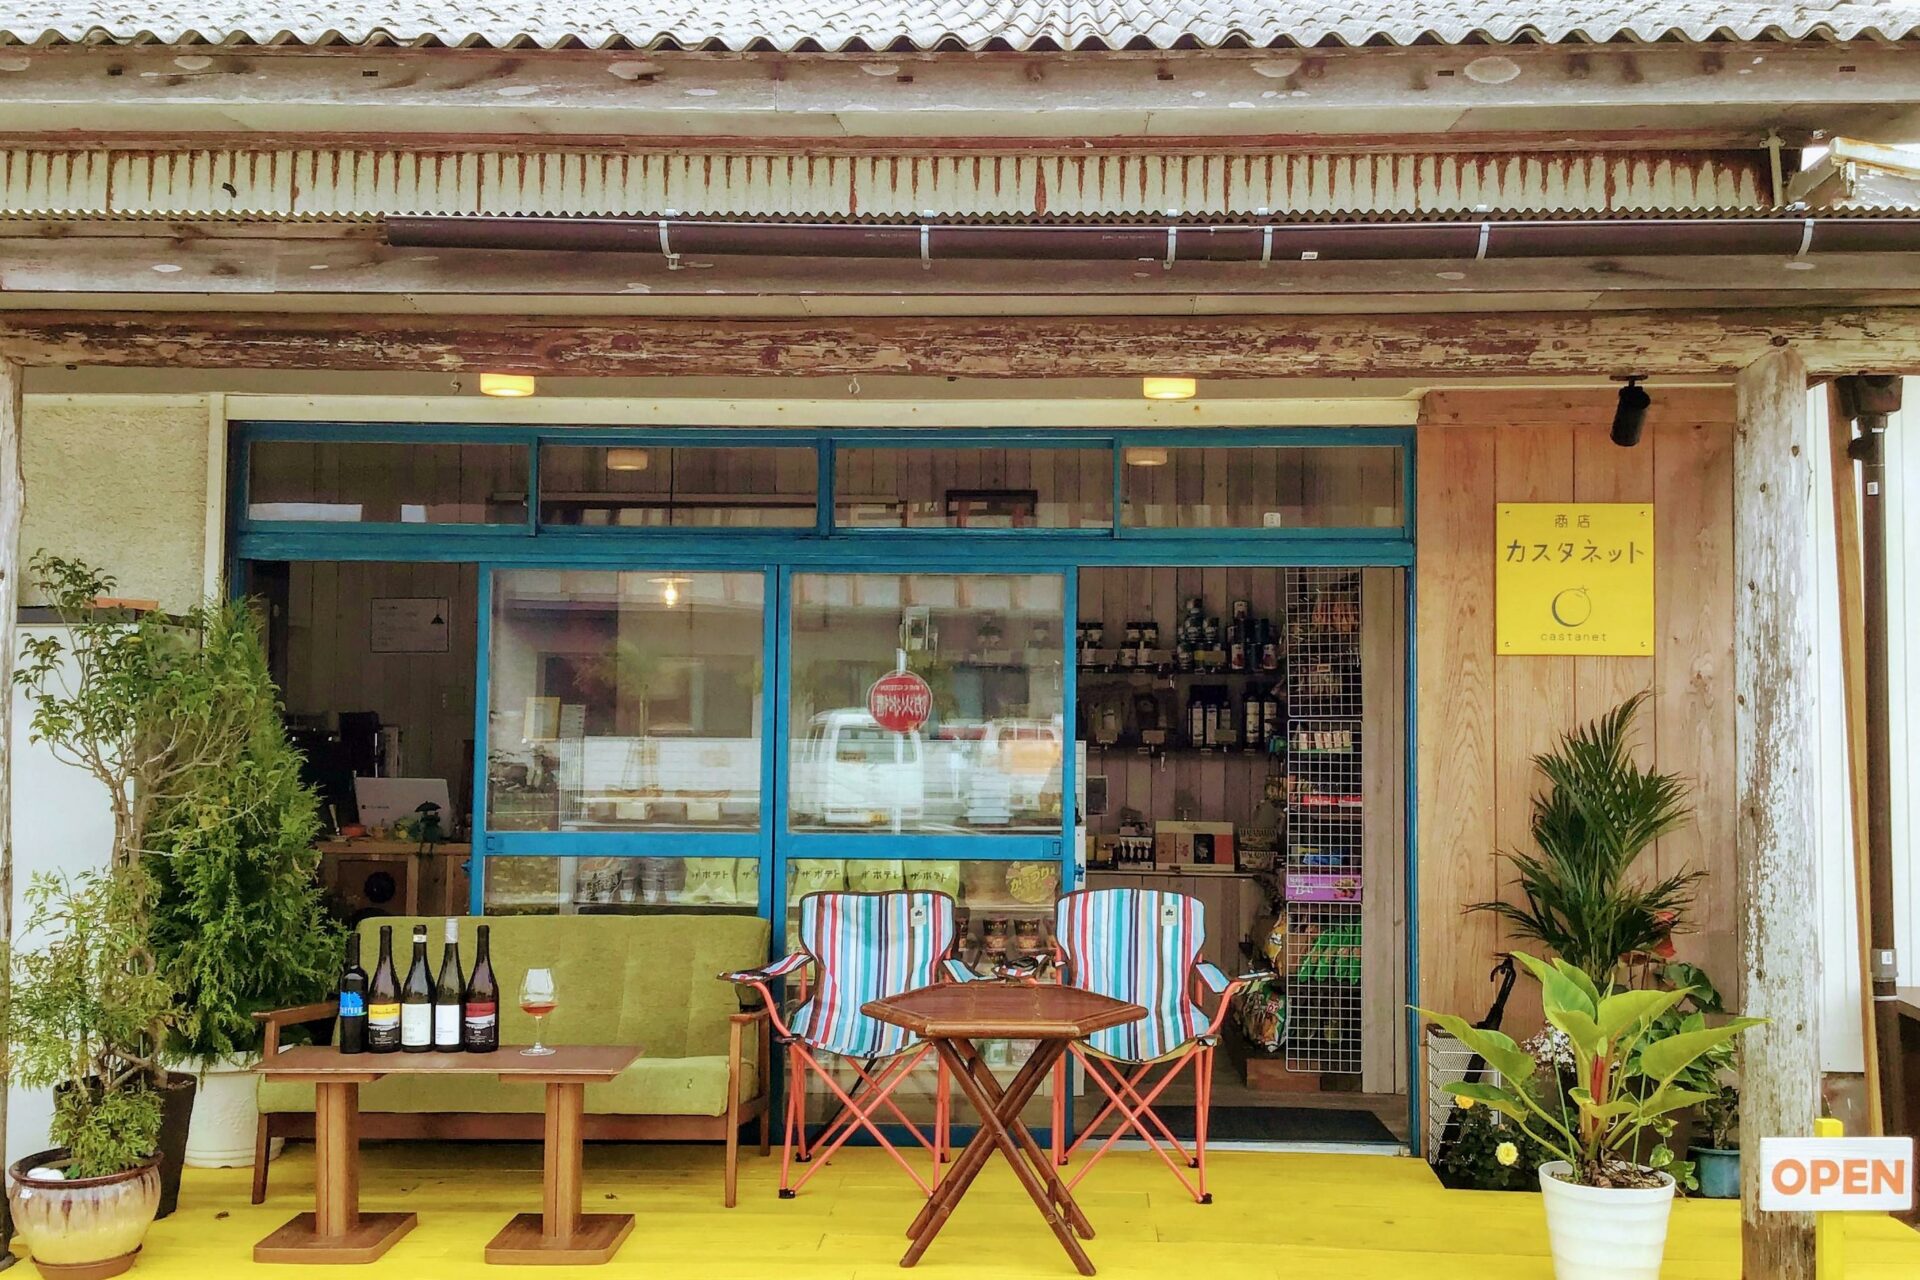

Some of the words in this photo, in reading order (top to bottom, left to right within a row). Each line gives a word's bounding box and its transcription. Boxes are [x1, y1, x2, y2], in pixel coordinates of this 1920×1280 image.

[1554, 514, 1591, 529] 商店
[1506, 539, 1644, 564] カスタネット
[1540, 632, 1607, 642] castanet
[1771, 1158, 1905, 1196] OPEN
